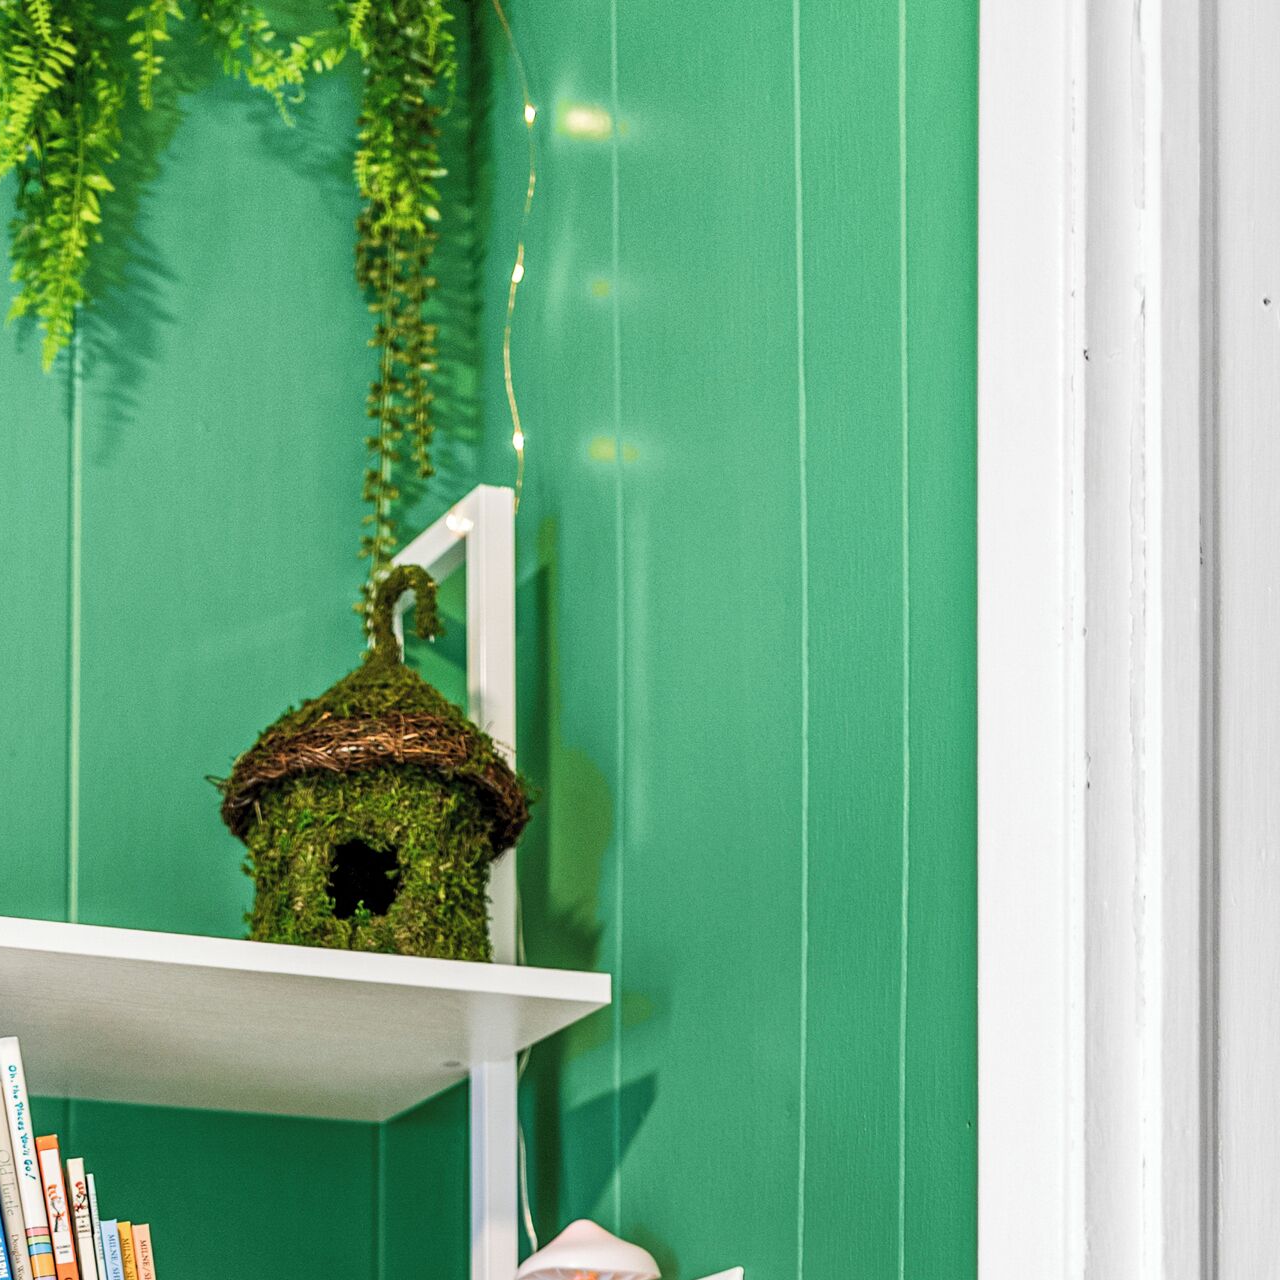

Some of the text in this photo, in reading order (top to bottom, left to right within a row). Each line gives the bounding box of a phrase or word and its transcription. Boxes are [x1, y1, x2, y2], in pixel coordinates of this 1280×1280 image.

[14, 1101, 27, 1130] Places
[2, 1180, 18, 1216] Turtle
[9, 1234, 22, 1263] Douglas
